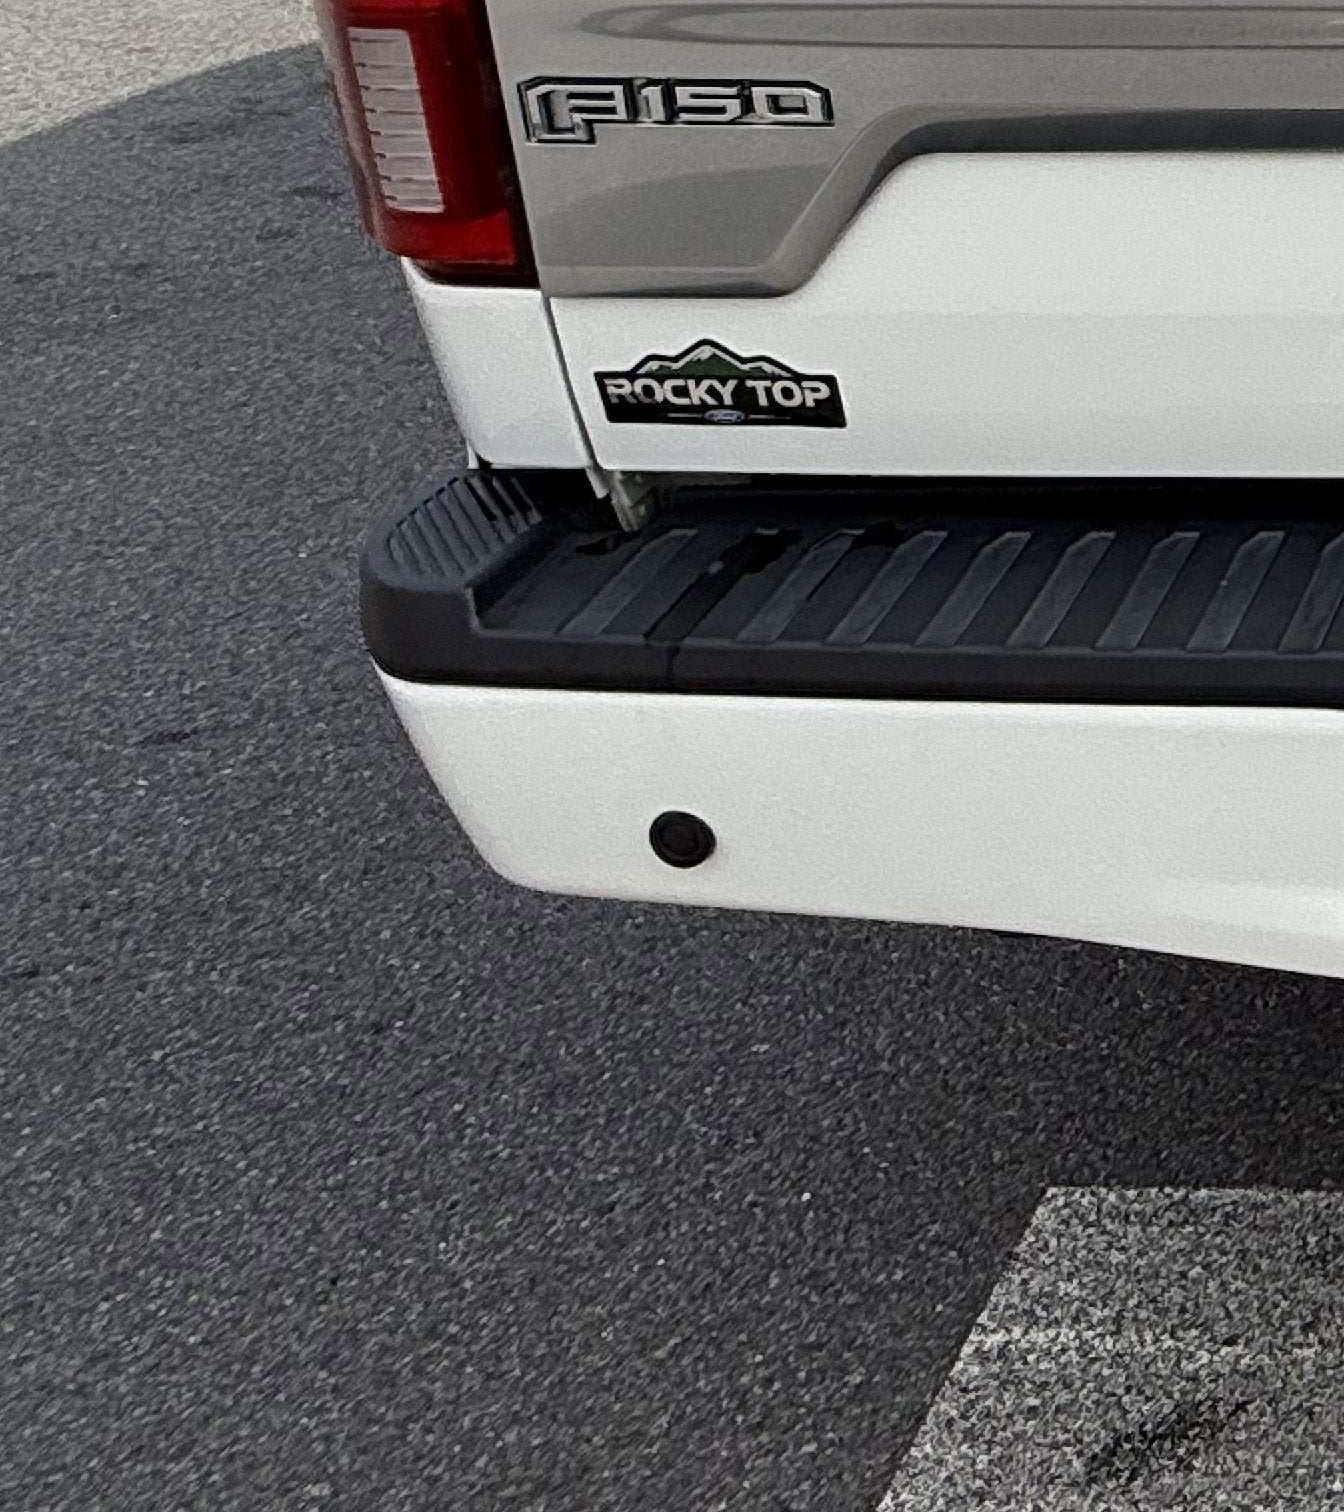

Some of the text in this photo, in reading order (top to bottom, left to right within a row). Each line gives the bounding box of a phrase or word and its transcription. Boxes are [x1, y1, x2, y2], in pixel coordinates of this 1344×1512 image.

[517, 76, 834, 144] F150
[604, 378, 831, 408] ROCKY TOP
